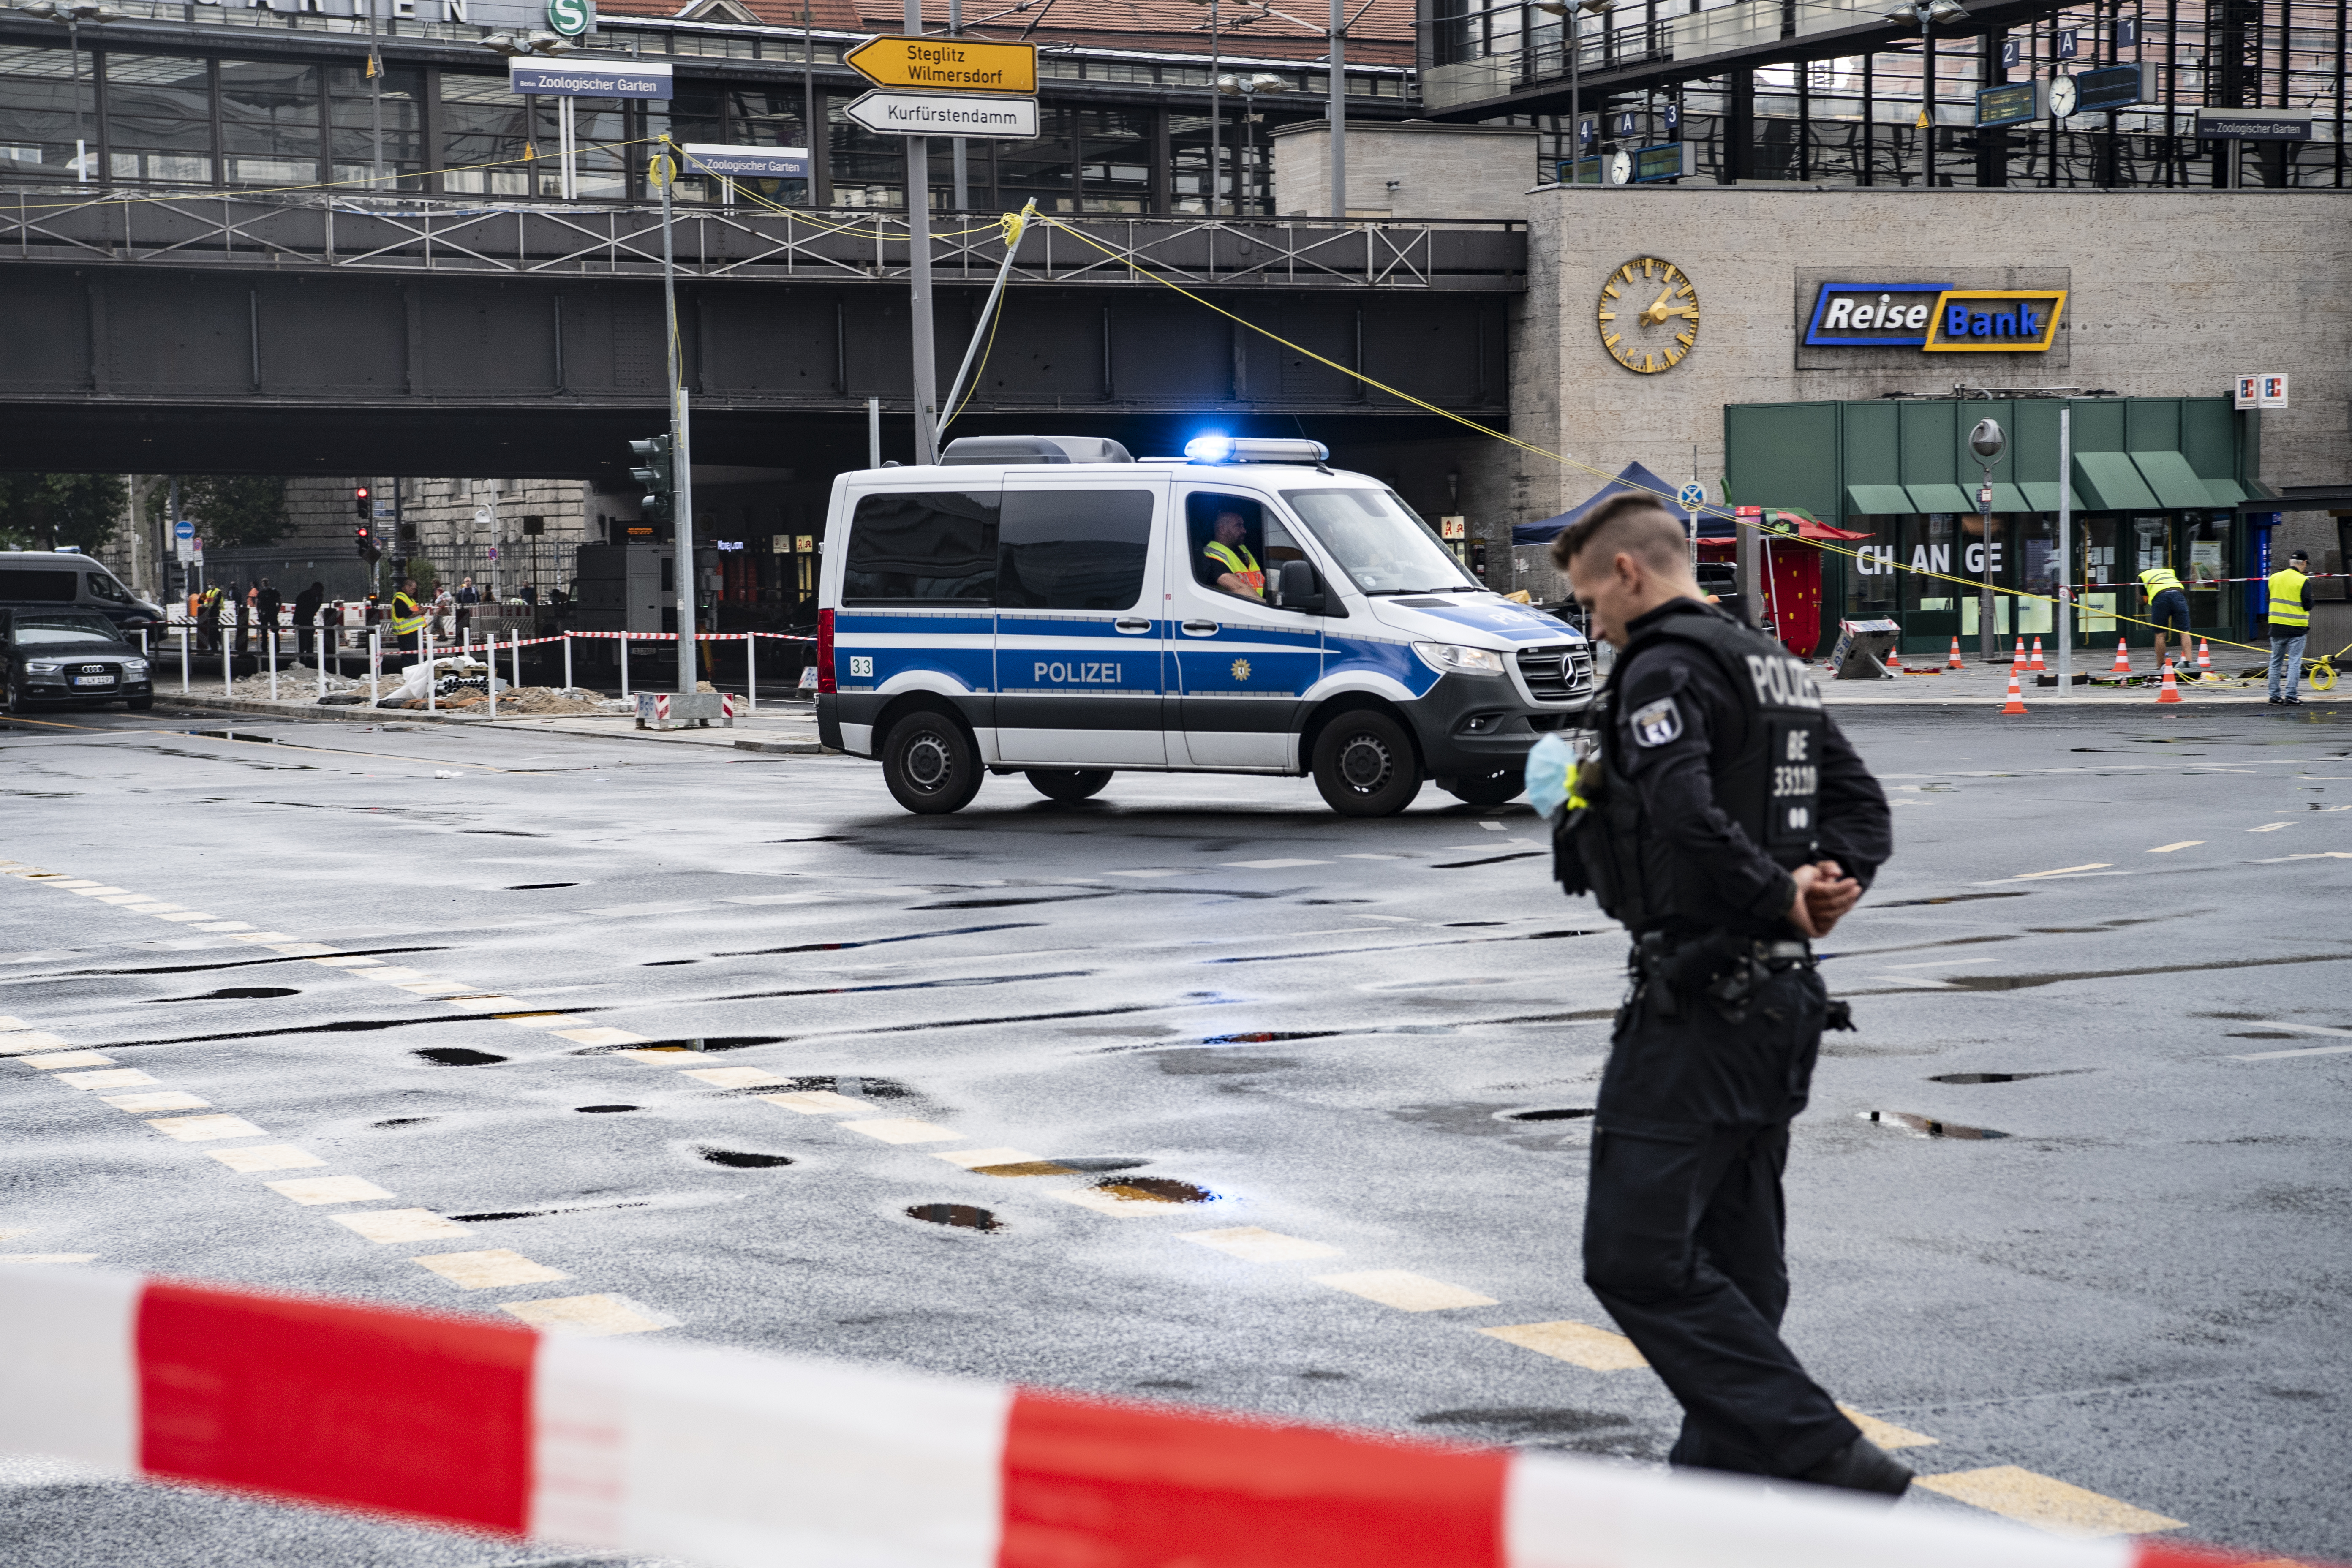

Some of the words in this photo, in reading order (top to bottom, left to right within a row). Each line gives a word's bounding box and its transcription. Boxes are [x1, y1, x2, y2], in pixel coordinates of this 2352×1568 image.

[2127, 20, 2134, 40] 1
[2062, 33, 2073, 52] A
[907, 45, 965, 65] Steglitz
[2004, 43, 2013, 63] 2
[538, 76, 615, 91] Zoologischer
[618, 79, 656, 92] Garten
[908, 65, 1002, 84] Wilmersdorf
[888, 105, 1017, 124] Kurfürstendamm
[1623, 114, 1632, 131] A
[1669, 105, 1676, 122] 3
[1581, 122, 1588, 138] 4
[2217, 123, 2271, 135] Zoologischer
[2272, 124, 2301, 134] Garten
[706, 159, 767, 172] Zoologischer
[769, 161, 800, 172] Garten
[1825, 294, 1928, 329] Reise
[1946, 303, 2039, 335] Bank
[853, 659, 870, 674] 33
[1034, 662, 1121, 683] POLIZEI
[1746, 655, 1821, 709] POLIZE
[1787, 730, 1810, 761] BE
